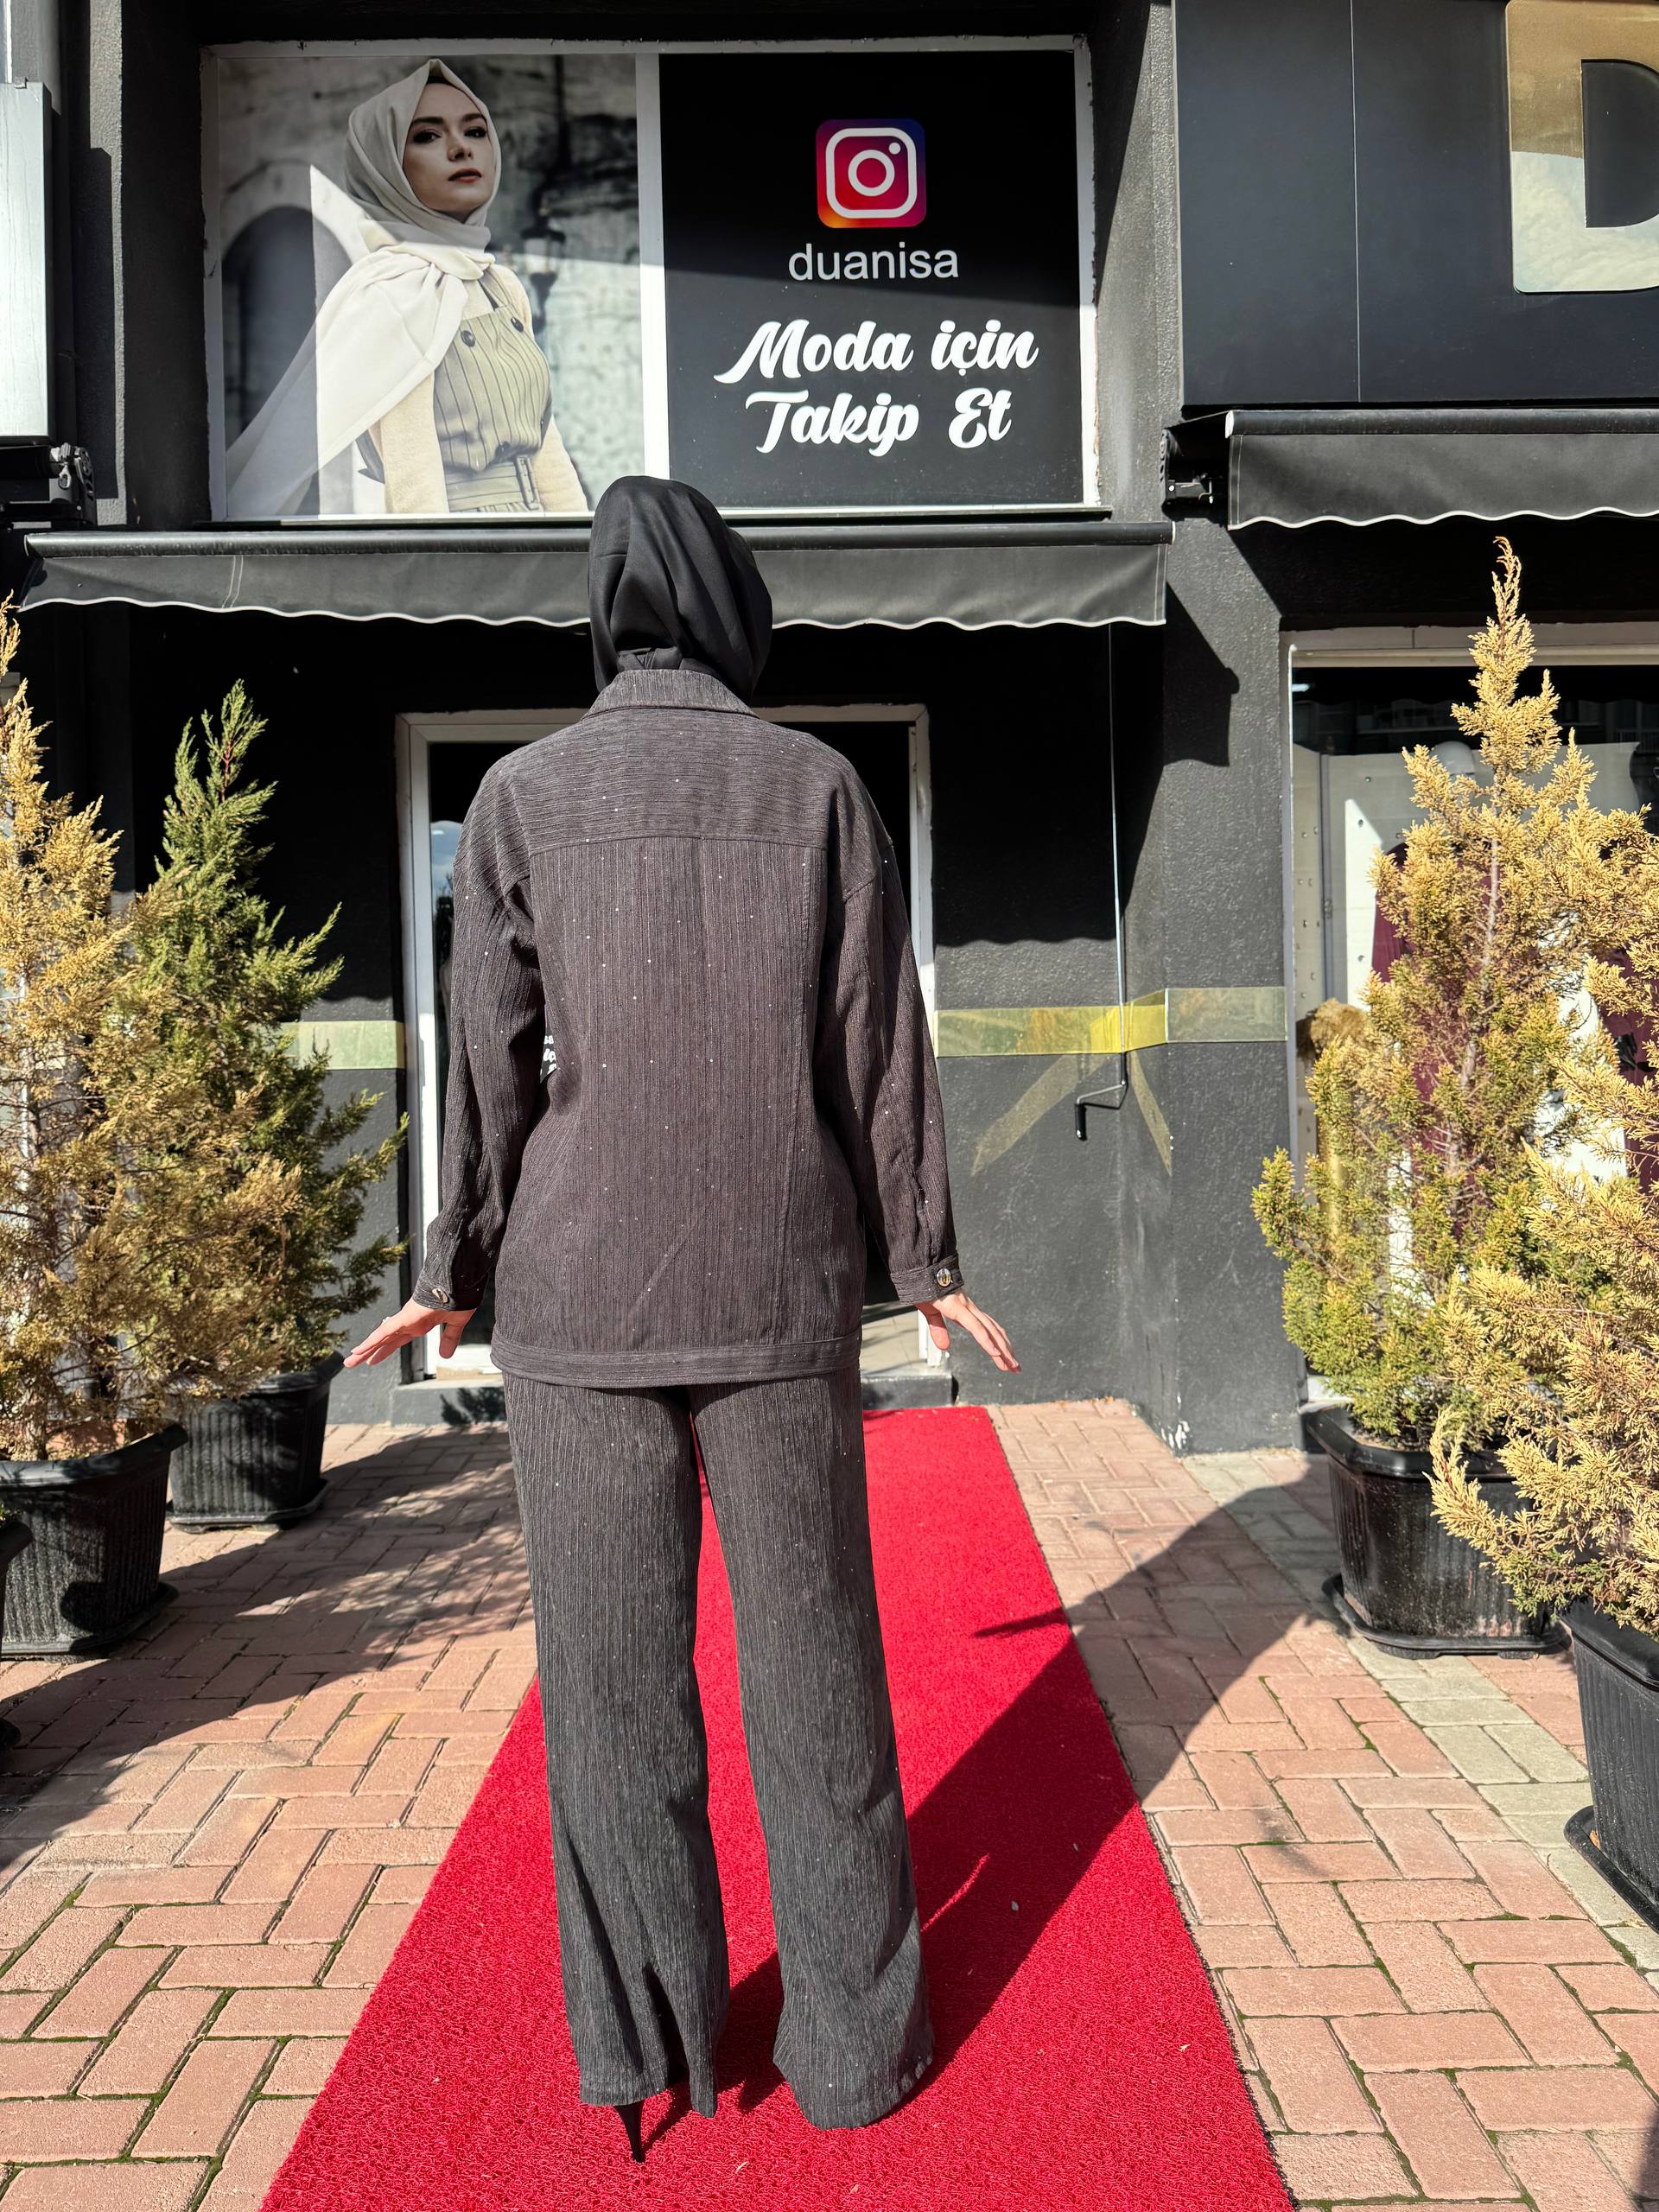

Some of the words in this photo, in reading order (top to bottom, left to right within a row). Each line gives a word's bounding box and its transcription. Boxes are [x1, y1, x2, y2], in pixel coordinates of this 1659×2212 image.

[788, 241, 959, 281] duanisa
[713, 319, 914, 385] Moda
[931, 319, 1039, 377] için
[745, 389, 920, 457] Takip
[948, 387, 1013, 449] Et
